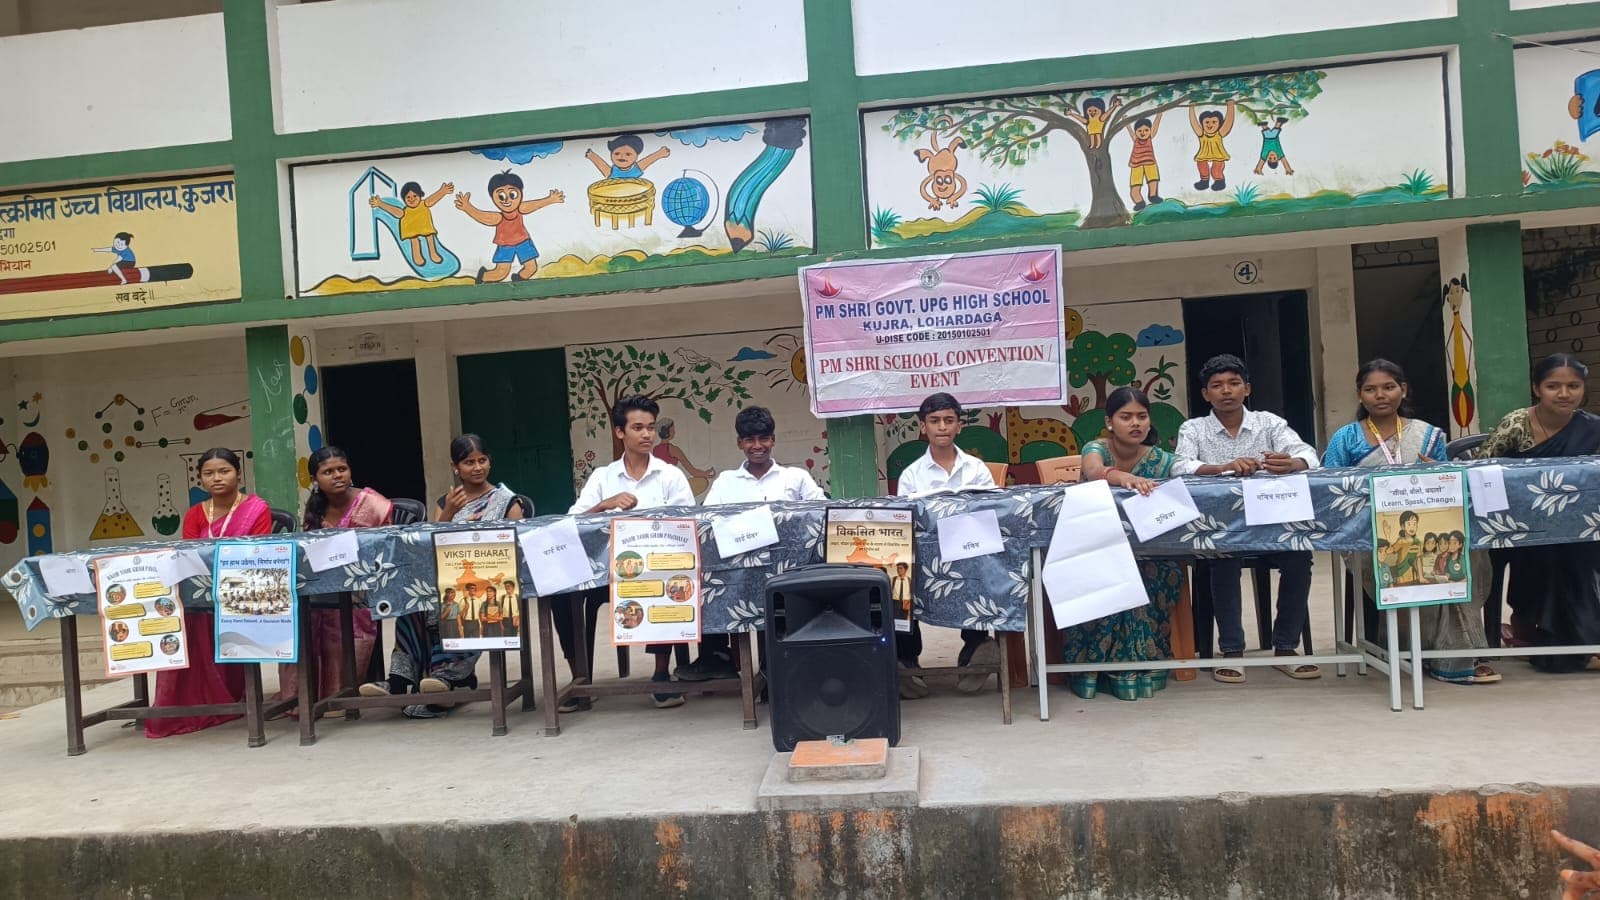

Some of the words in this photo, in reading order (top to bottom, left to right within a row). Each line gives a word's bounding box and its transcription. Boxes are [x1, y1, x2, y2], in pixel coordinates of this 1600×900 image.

[59, 193, 102, 218] उच्च
[0, 240, 56, 255] 50102501
[1238, 264, 1253, 280] 4
[815, 304, 835, 320] PM
[839, 301, 871, 319] SHRI
[876, 298, 916, 316] GOVT.
[920, 296, 948, 314] UPG
[953, 293, 988, 311] HIGH
[993, 288, 1050, 307] SCHOOL
[863, 317, 913, 332] KUJRA,
[918, 311, 1003, 329] LOHARDAGA
[876, 333, 904, 345] U-DISE
[906, 332, 931, 343] CODE
[937, 328, 991, 341] 20150102501
[820, 357, 842, 375] PM
[846, 354, 880, 372] SHRI
[884, 351, 942, 370] SCHOOL
[946, 344, 1045, 365] CONVENTION
[910, 371, 961, 389] EVENT
[1427, 496, 1456, 505] Change)
[836, 525, 875, 537] विकसित
[879, 527, 903, 537] भारत
[443, 550, 472, 559] VIKSIT
[474, 548, 509, 558] BHARAT
